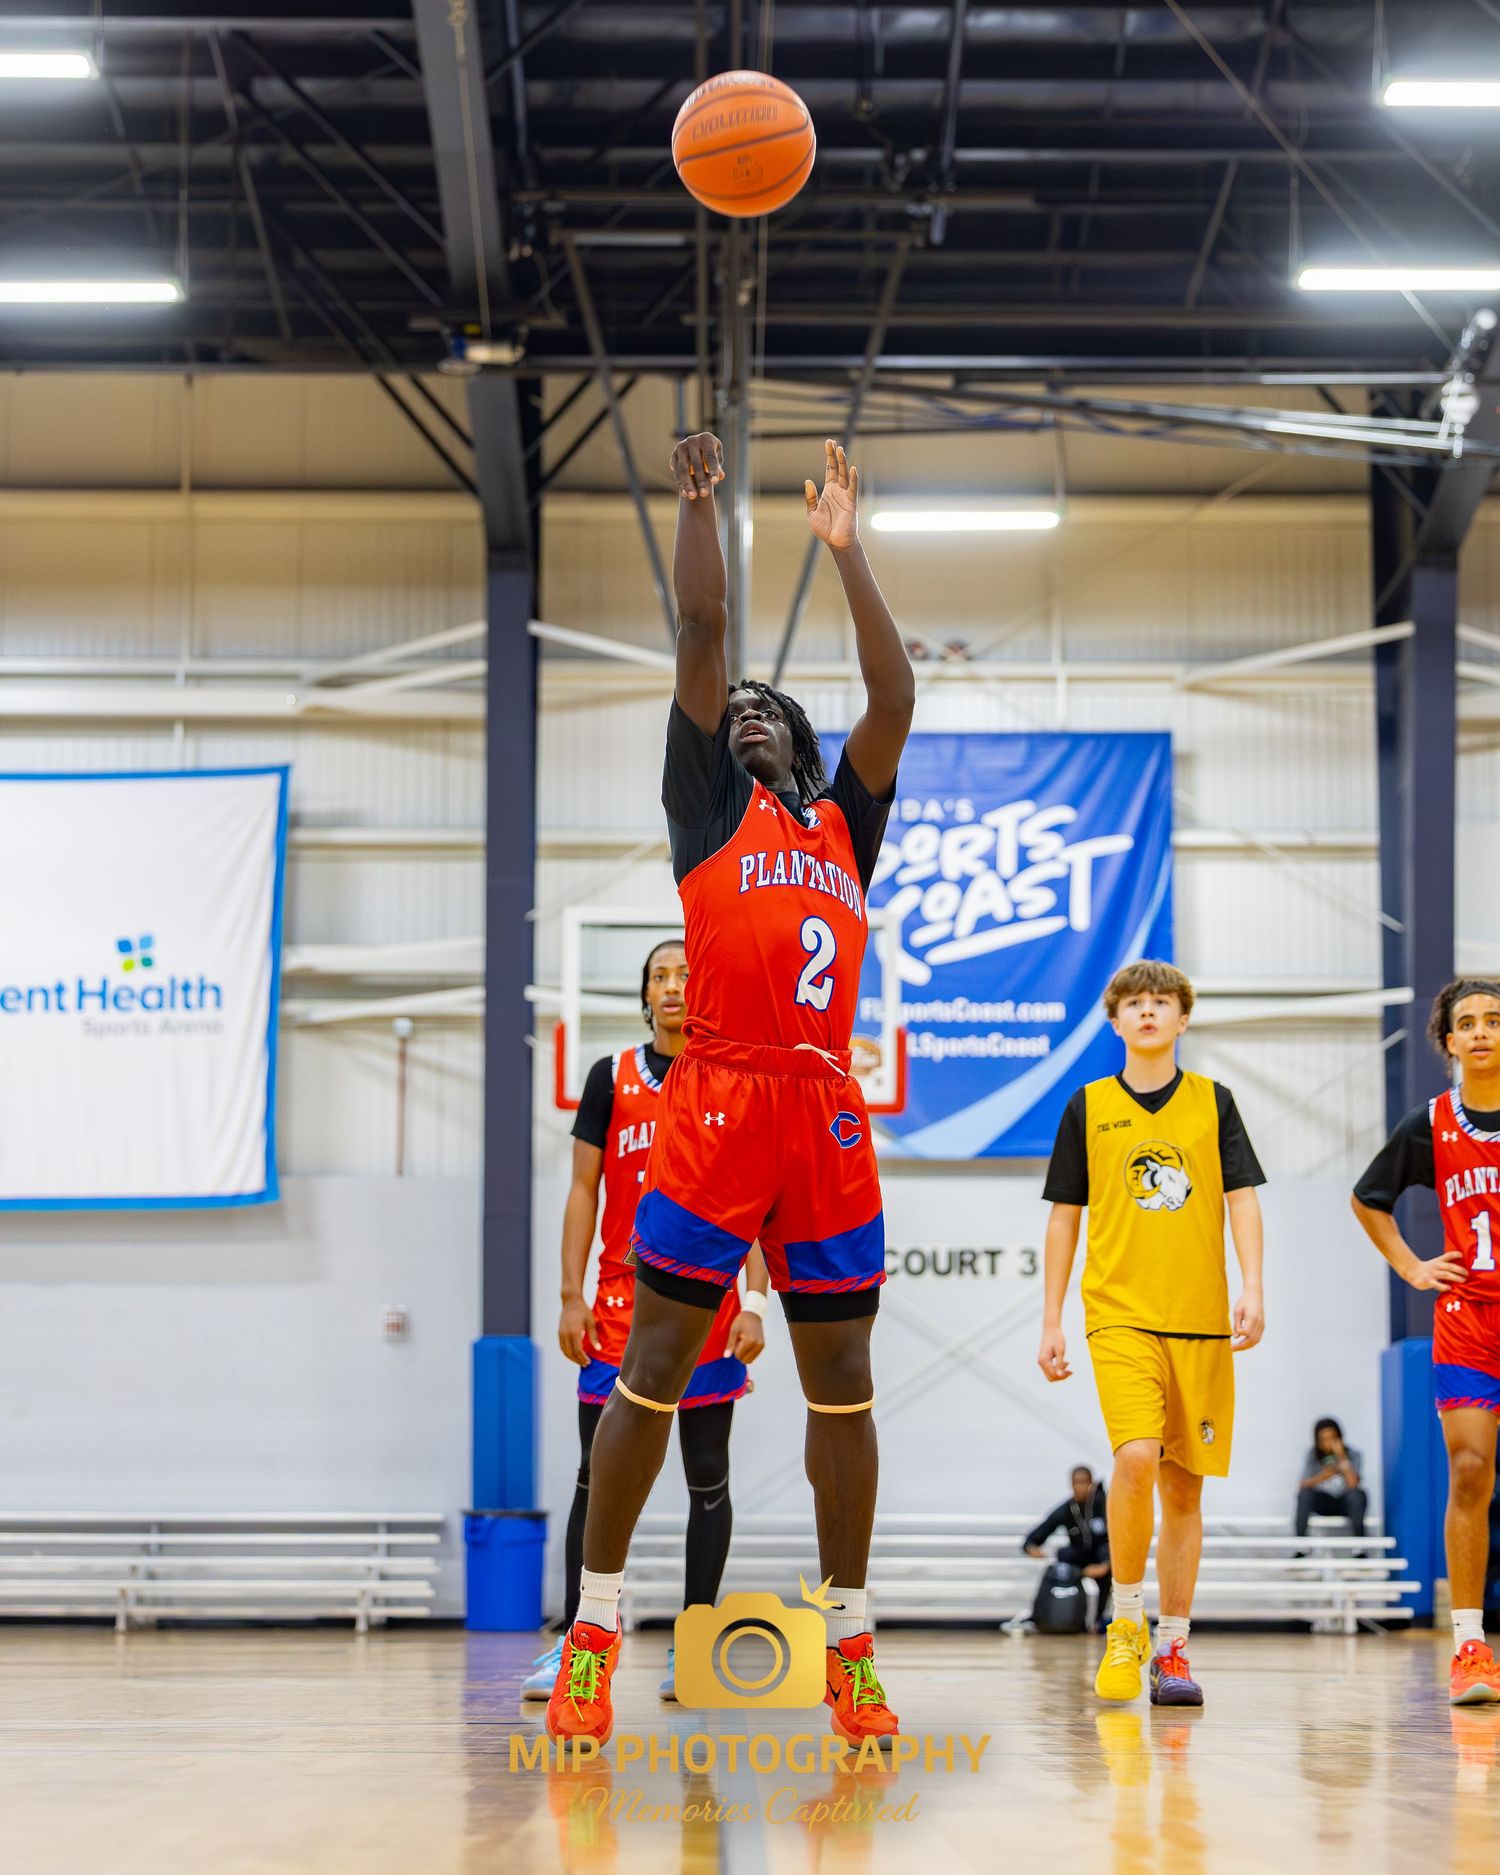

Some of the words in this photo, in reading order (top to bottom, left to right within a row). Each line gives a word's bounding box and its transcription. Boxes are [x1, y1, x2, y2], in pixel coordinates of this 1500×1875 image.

[739, 849, 863, 923] PLANTATION
[874, 833, 1134, 987] COAST
[794, 914, 838, 1013] 2
[861, 997, 1066, 1024] FLportsCoast.com
[1445, 1166, 1500, 1208] PLANT
[884, 1248, 1003, 1276] COURT
[1020, 1248, 1038, 1276] 3
[1470, 1210, 1497, 1272] 1
